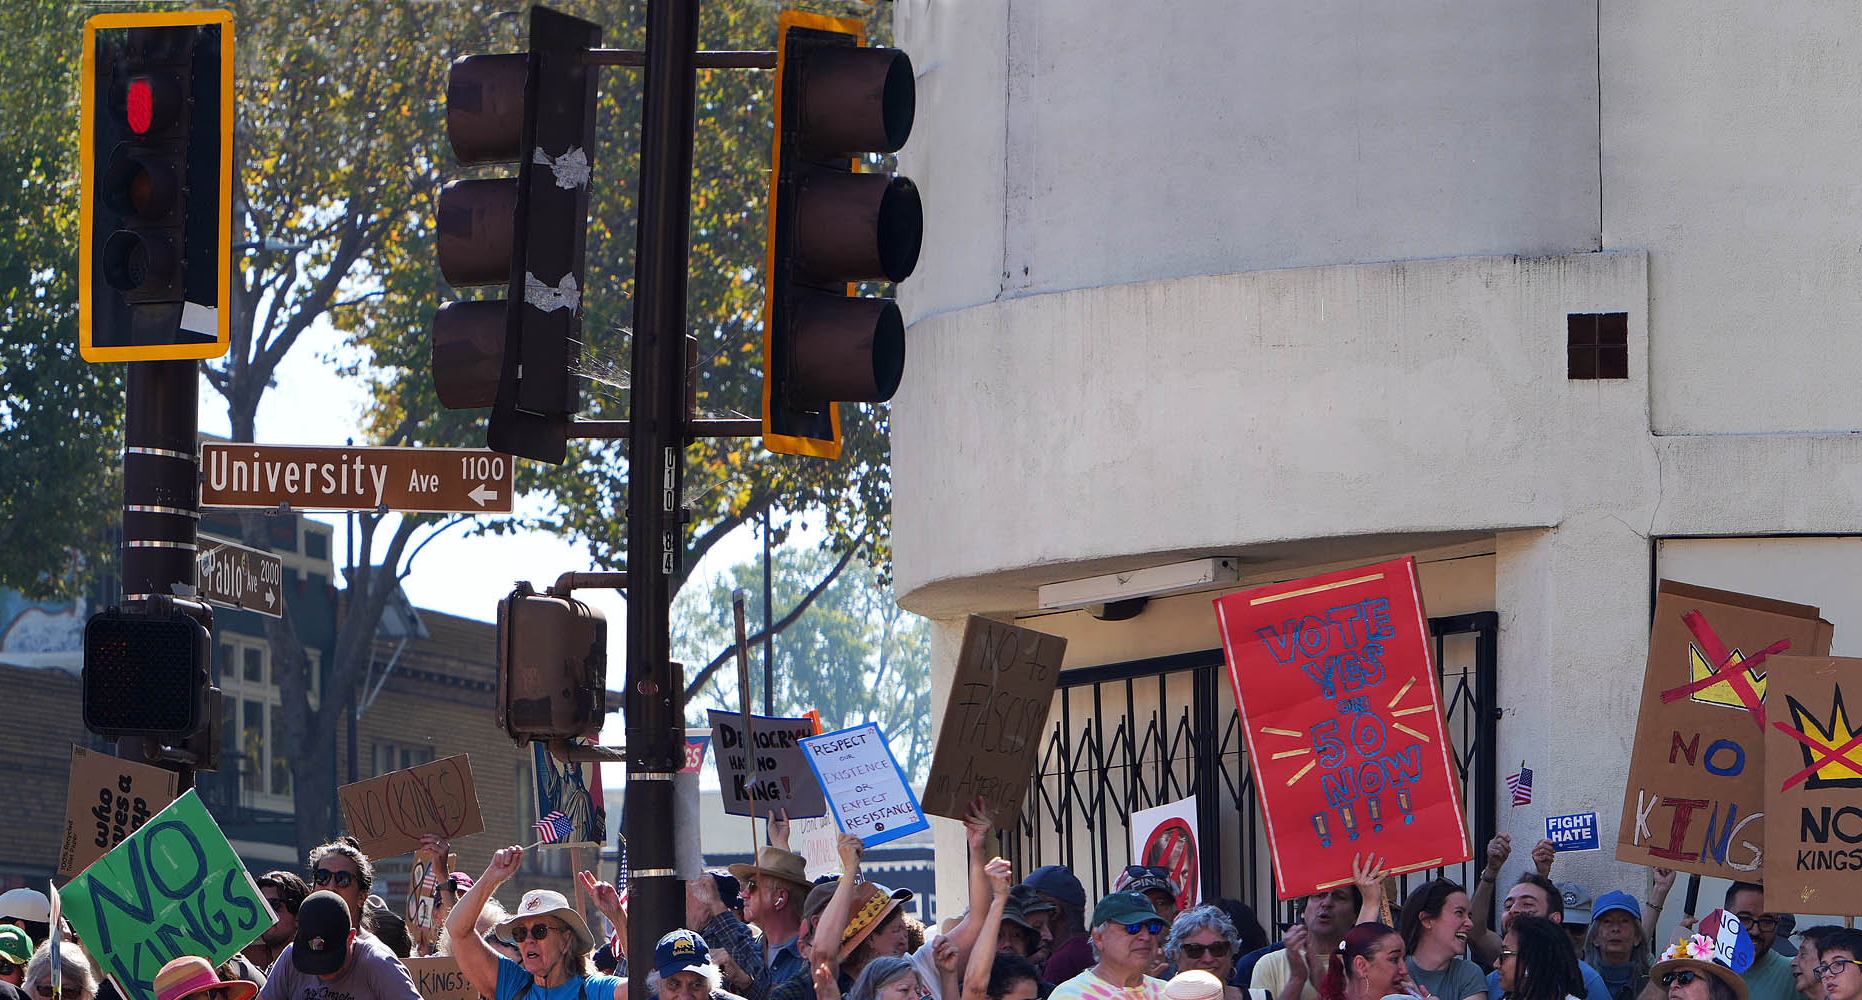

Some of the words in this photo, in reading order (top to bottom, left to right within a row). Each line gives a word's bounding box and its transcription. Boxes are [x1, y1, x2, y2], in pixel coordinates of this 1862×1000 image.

[209, 450, 388, 507] University
[408, 469, 440, 493] Ave
[461, 456, 504, 481] 1100
[208, 548, 242, 600] Pablo
[260, 559, 279, 586] 2000
[981, 625, 1018, 673] NO
[1256, 598, 1395, 665] VOTE
[1302, 643, 1386, 699] YES
[1337, 696, 1370, 714] ON
[812, 733, 868, 757] RESPECT
[839, 753, 855, 762] OUR
[1310, 712, 1387, 768] 50
[1669, 731, 1745, 776] NO
[757, 756, 776, 771] NO
[823, 759, 890, 785] EXISTENCE
[1321, 744, 1421, 808] NOW
[343, 789, 387, 841] NO
[393, 768, 463, 829] KINGS
[841, 793, 887, 813] EXPECT
[855, 783, 873, 793] OR
[92, 787, 113, 848] who
[845, 801, 915, 830] RESISTANCE
[1548, 814, 1594, 831] FIGHT
[1551, 828, 1592, 842] HATE
[88, 820, 208, 954] NO
[1714, 910, 1741, 936] NO
